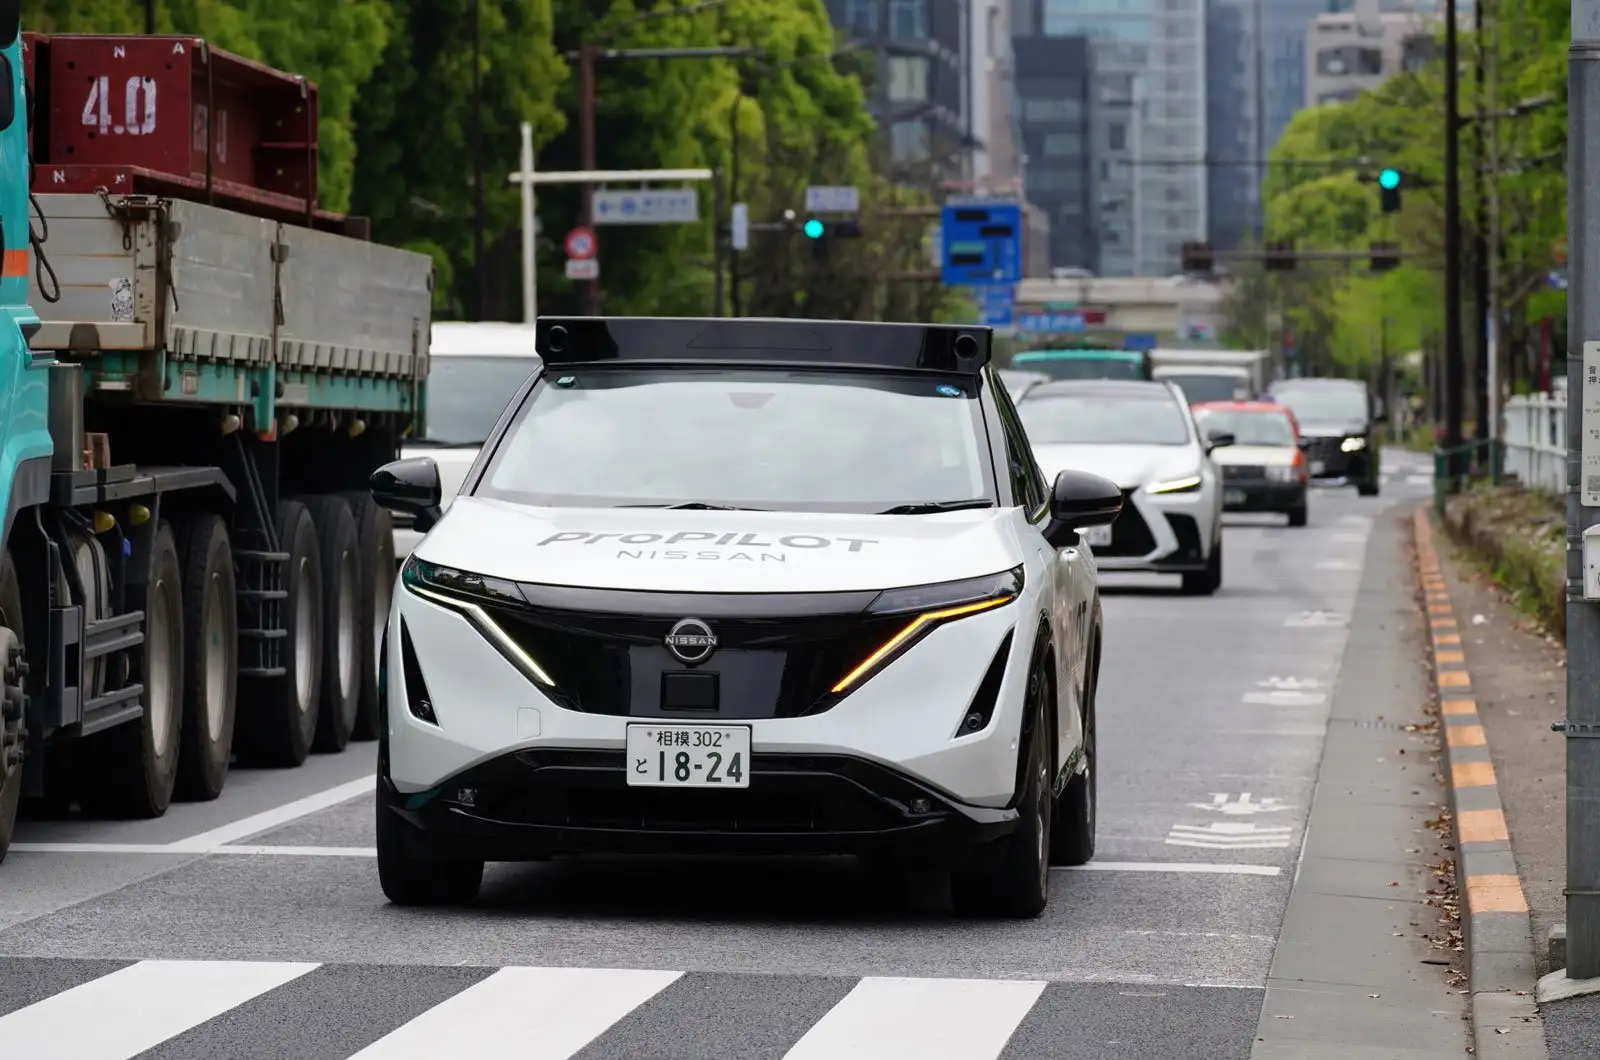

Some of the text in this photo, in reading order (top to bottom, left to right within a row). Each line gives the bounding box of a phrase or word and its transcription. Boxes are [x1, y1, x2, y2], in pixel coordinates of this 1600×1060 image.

[114, 42, 185, 58] N A
[81, 76, 157, 135] 4.0
[536, 531, 880, 552] proPILOT
[616, 550, 786, 562] NISSAN
[665, 637, 717, 645] NISSAN
[636, 750, 743, 783] と 18-24
